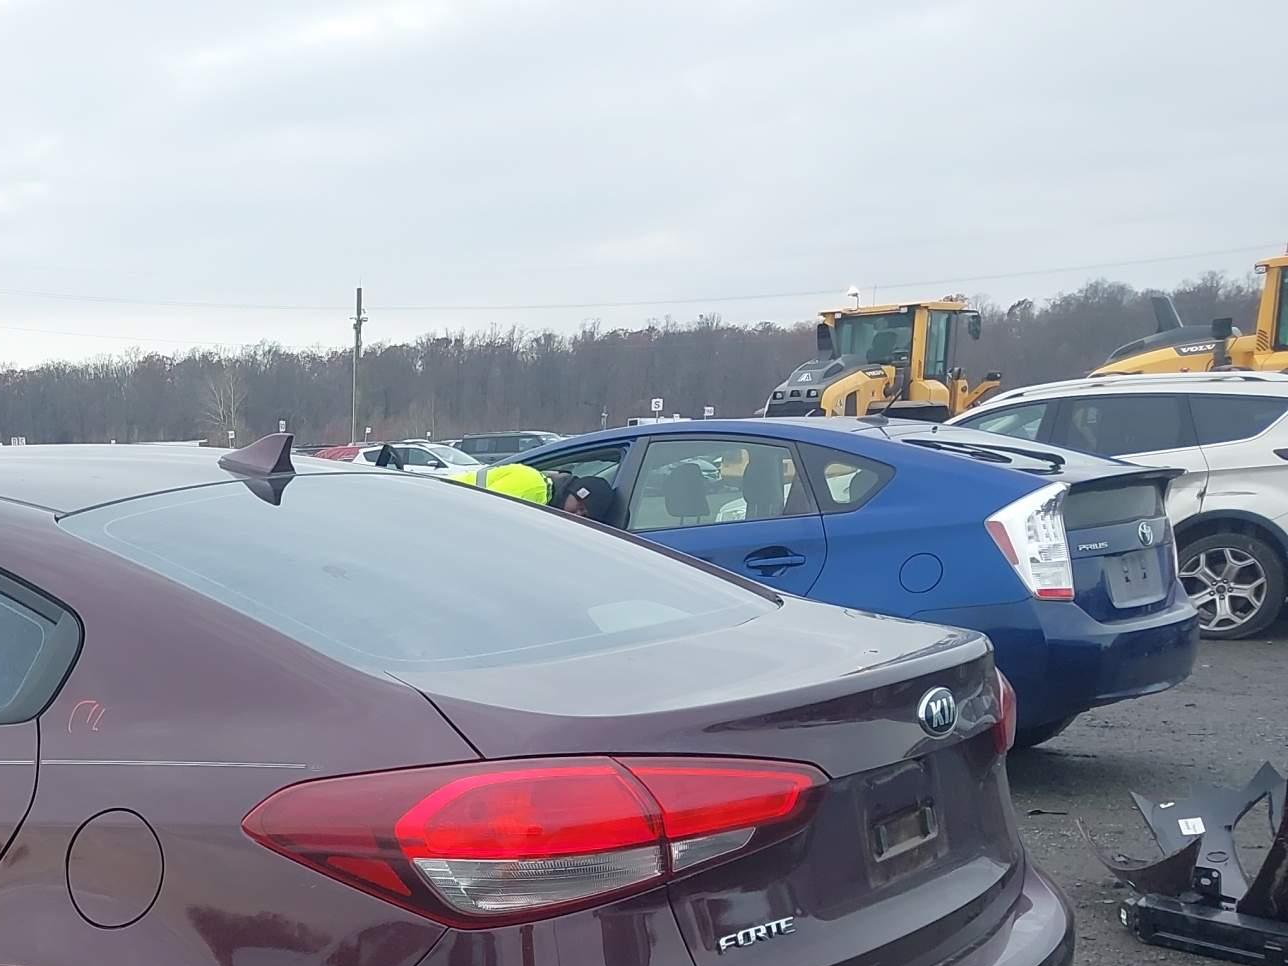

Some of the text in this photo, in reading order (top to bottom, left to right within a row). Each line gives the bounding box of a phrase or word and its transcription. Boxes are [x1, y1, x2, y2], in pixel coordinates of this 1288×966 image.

[1180, 344, 1216, 353] VOLV
[654, 400, 661, 410] S
[1078, 541, 1109, 551] PRIUS
[928, 695, 955, 728] KIA
[719, 916, 796, 951] FORTE
